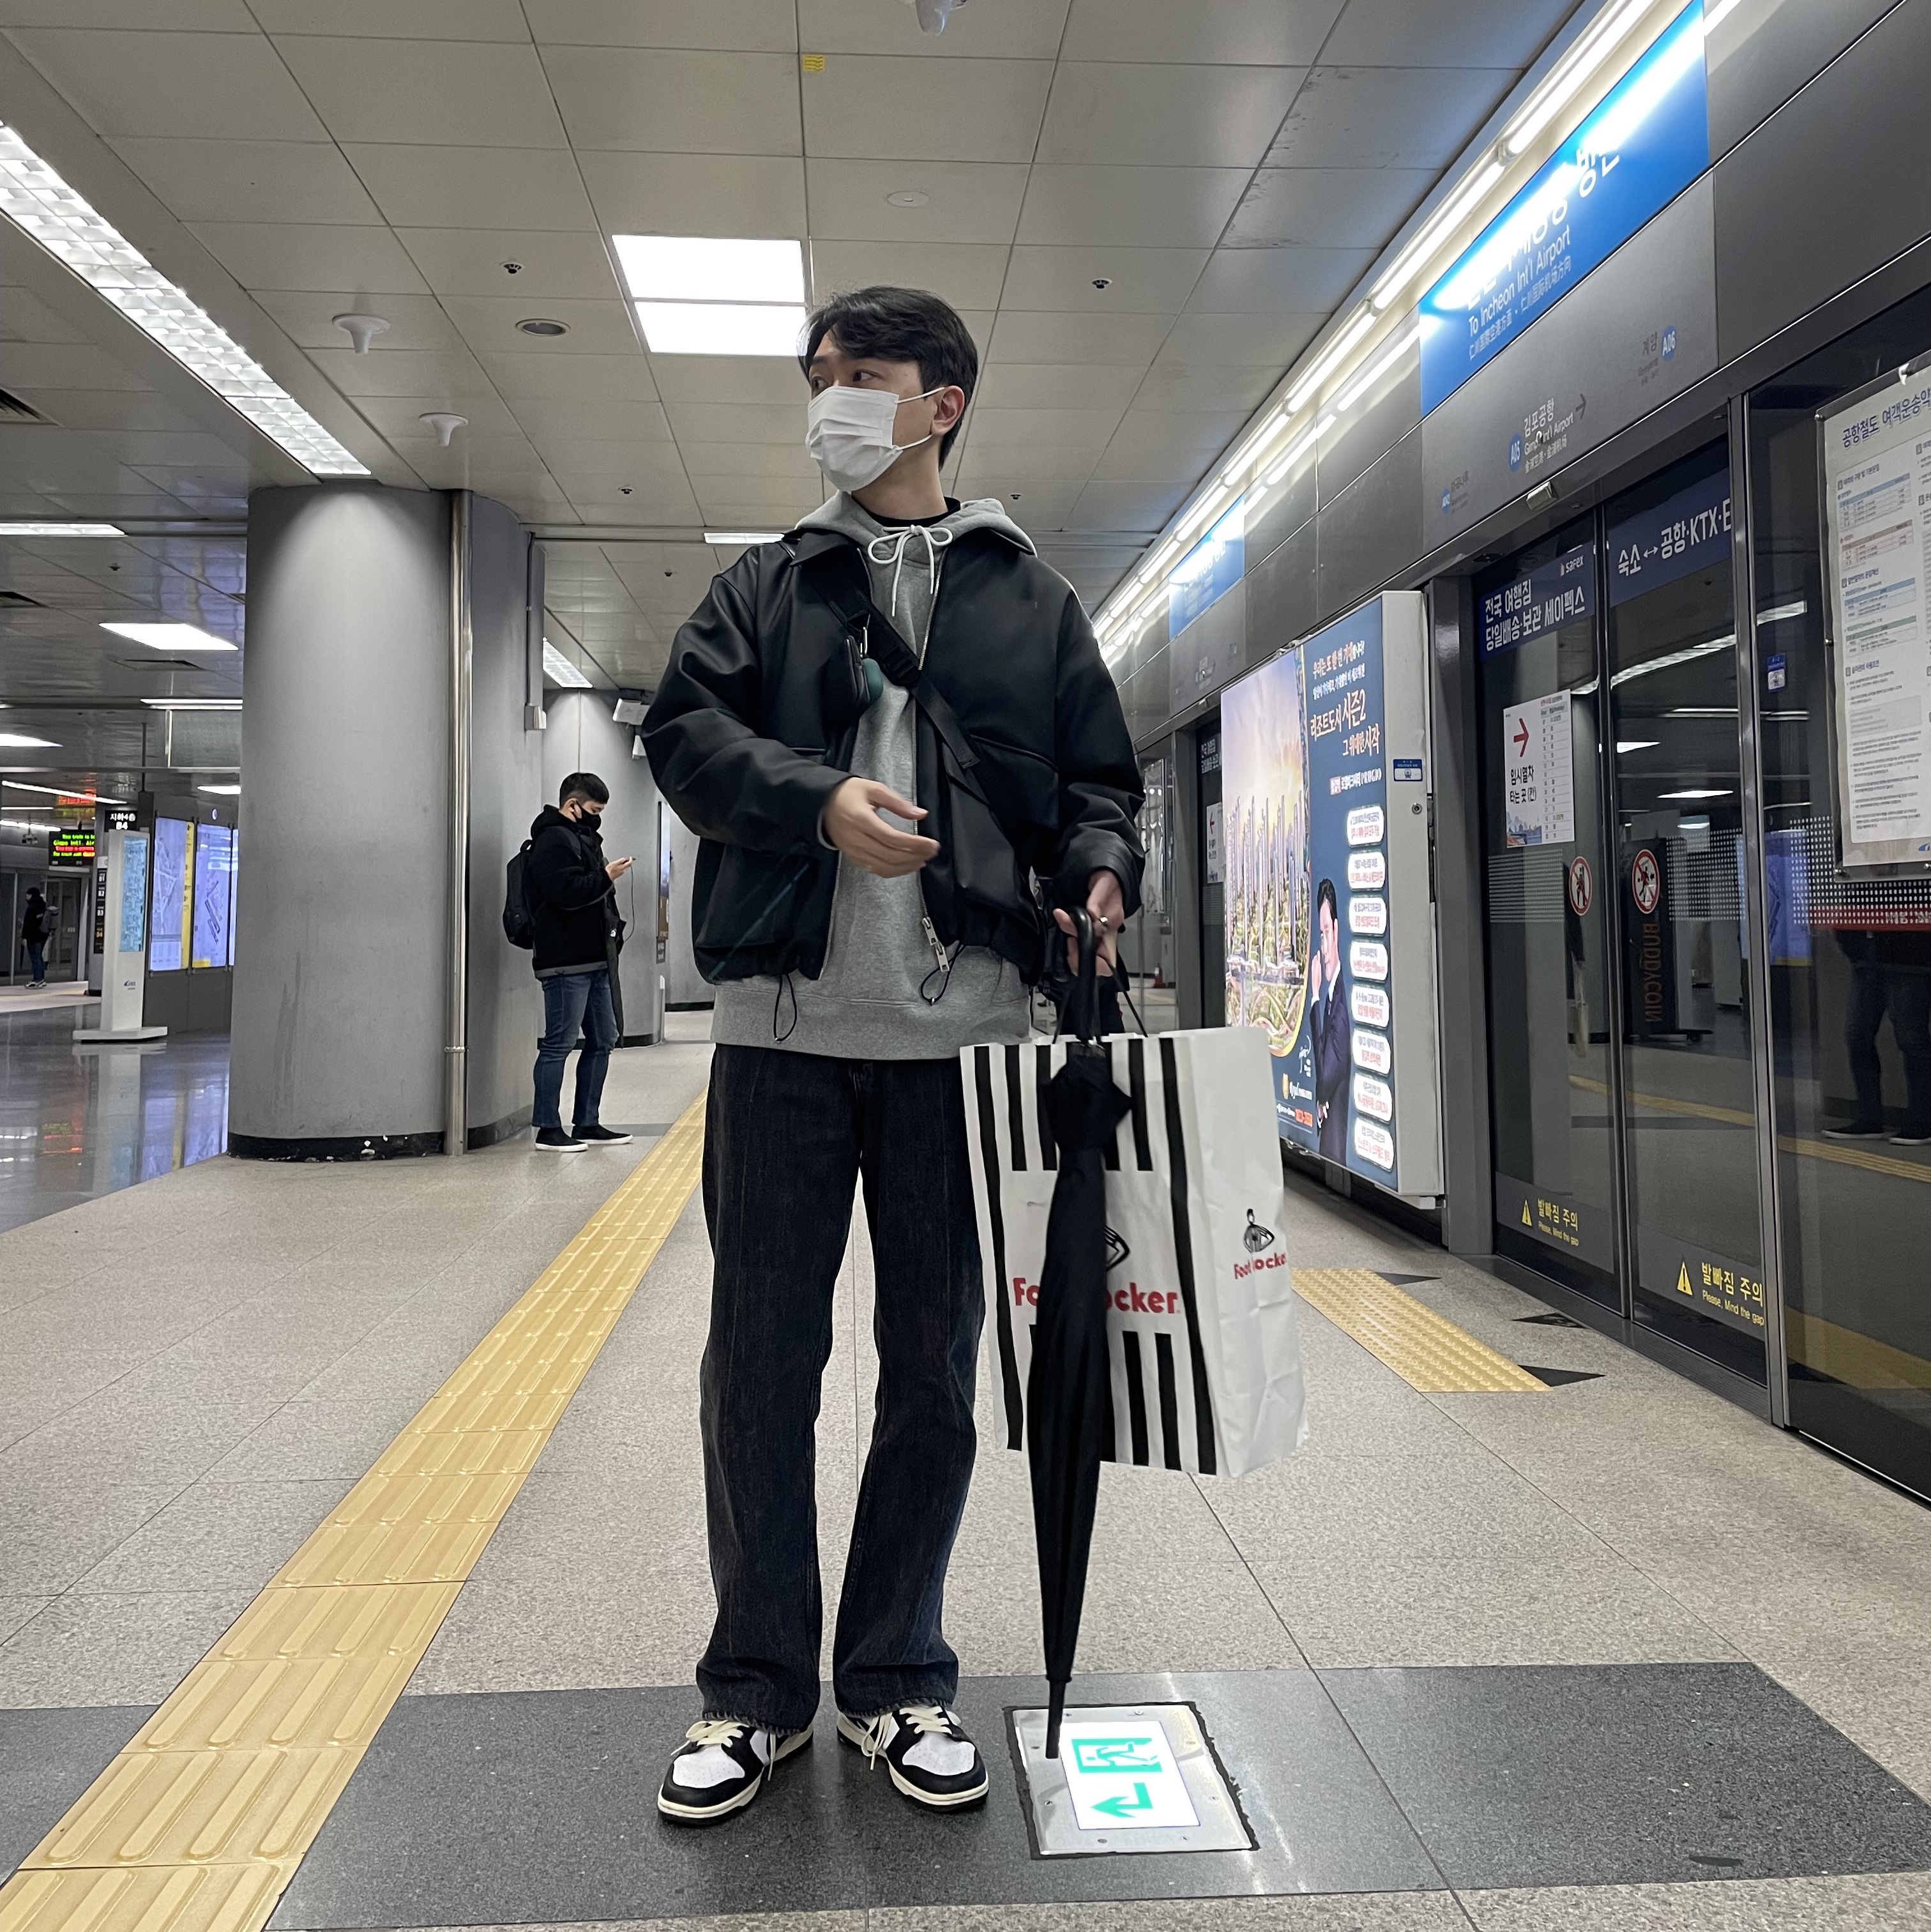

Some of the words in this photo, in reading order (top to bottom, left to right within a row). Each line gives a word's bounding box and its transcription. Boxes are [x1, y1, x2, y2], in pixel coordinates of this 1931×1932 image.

[1469, 316, 1478, 337] To
[1481, 282, 1515, 327] Incheon
[1517, 257, 1533, 293] Int'l
[1536, 224, 1571, 275] Airport
[1524, 397, 1555, 438] 김포공항
[1553, 412, 1573, 436] Airport
[1842, 416, 1879, 448] 공항철도
[1618, 544, 1642, 576] 숙소
[1485, 594, 1502, 623] 전국
[1504, 579, 1531, 613] 여행짐
[1544, 586, 1585, 627] 세이펙스
[1310, 704, 1342, 742] 리조트도시
[1342, 689, 1366, 729] 시즌2
[1342, 740, 1349, 756] 그
[1365, 723, 1380, 757] 시작
[1361, 768, 1382, 784] PRUGIO
[1511, 764, 1534, 786] 임시열차
[1510, 790, 1520, 804] 타는
[1521, 789, 1526, 803] 곳
[1527, 786, 1536, 802] (칸)
[1538, 1198, 1559, 1224] 발빠짐
[1563, 1208, 1578, 1231] 주의
[1013, 1277, 1041, 1307] Fo
[1105, 1282, 1178, 1314] cker
[1702, 1262, 1734, 1295] 발빠짐
[1739, 1277, 1762, 1307] 주의
[1725, 1298, 1739, 1314] Mind
[1741, 1306, 1750, 1320] the
[1752, 1313, 1764, 1327] gap
